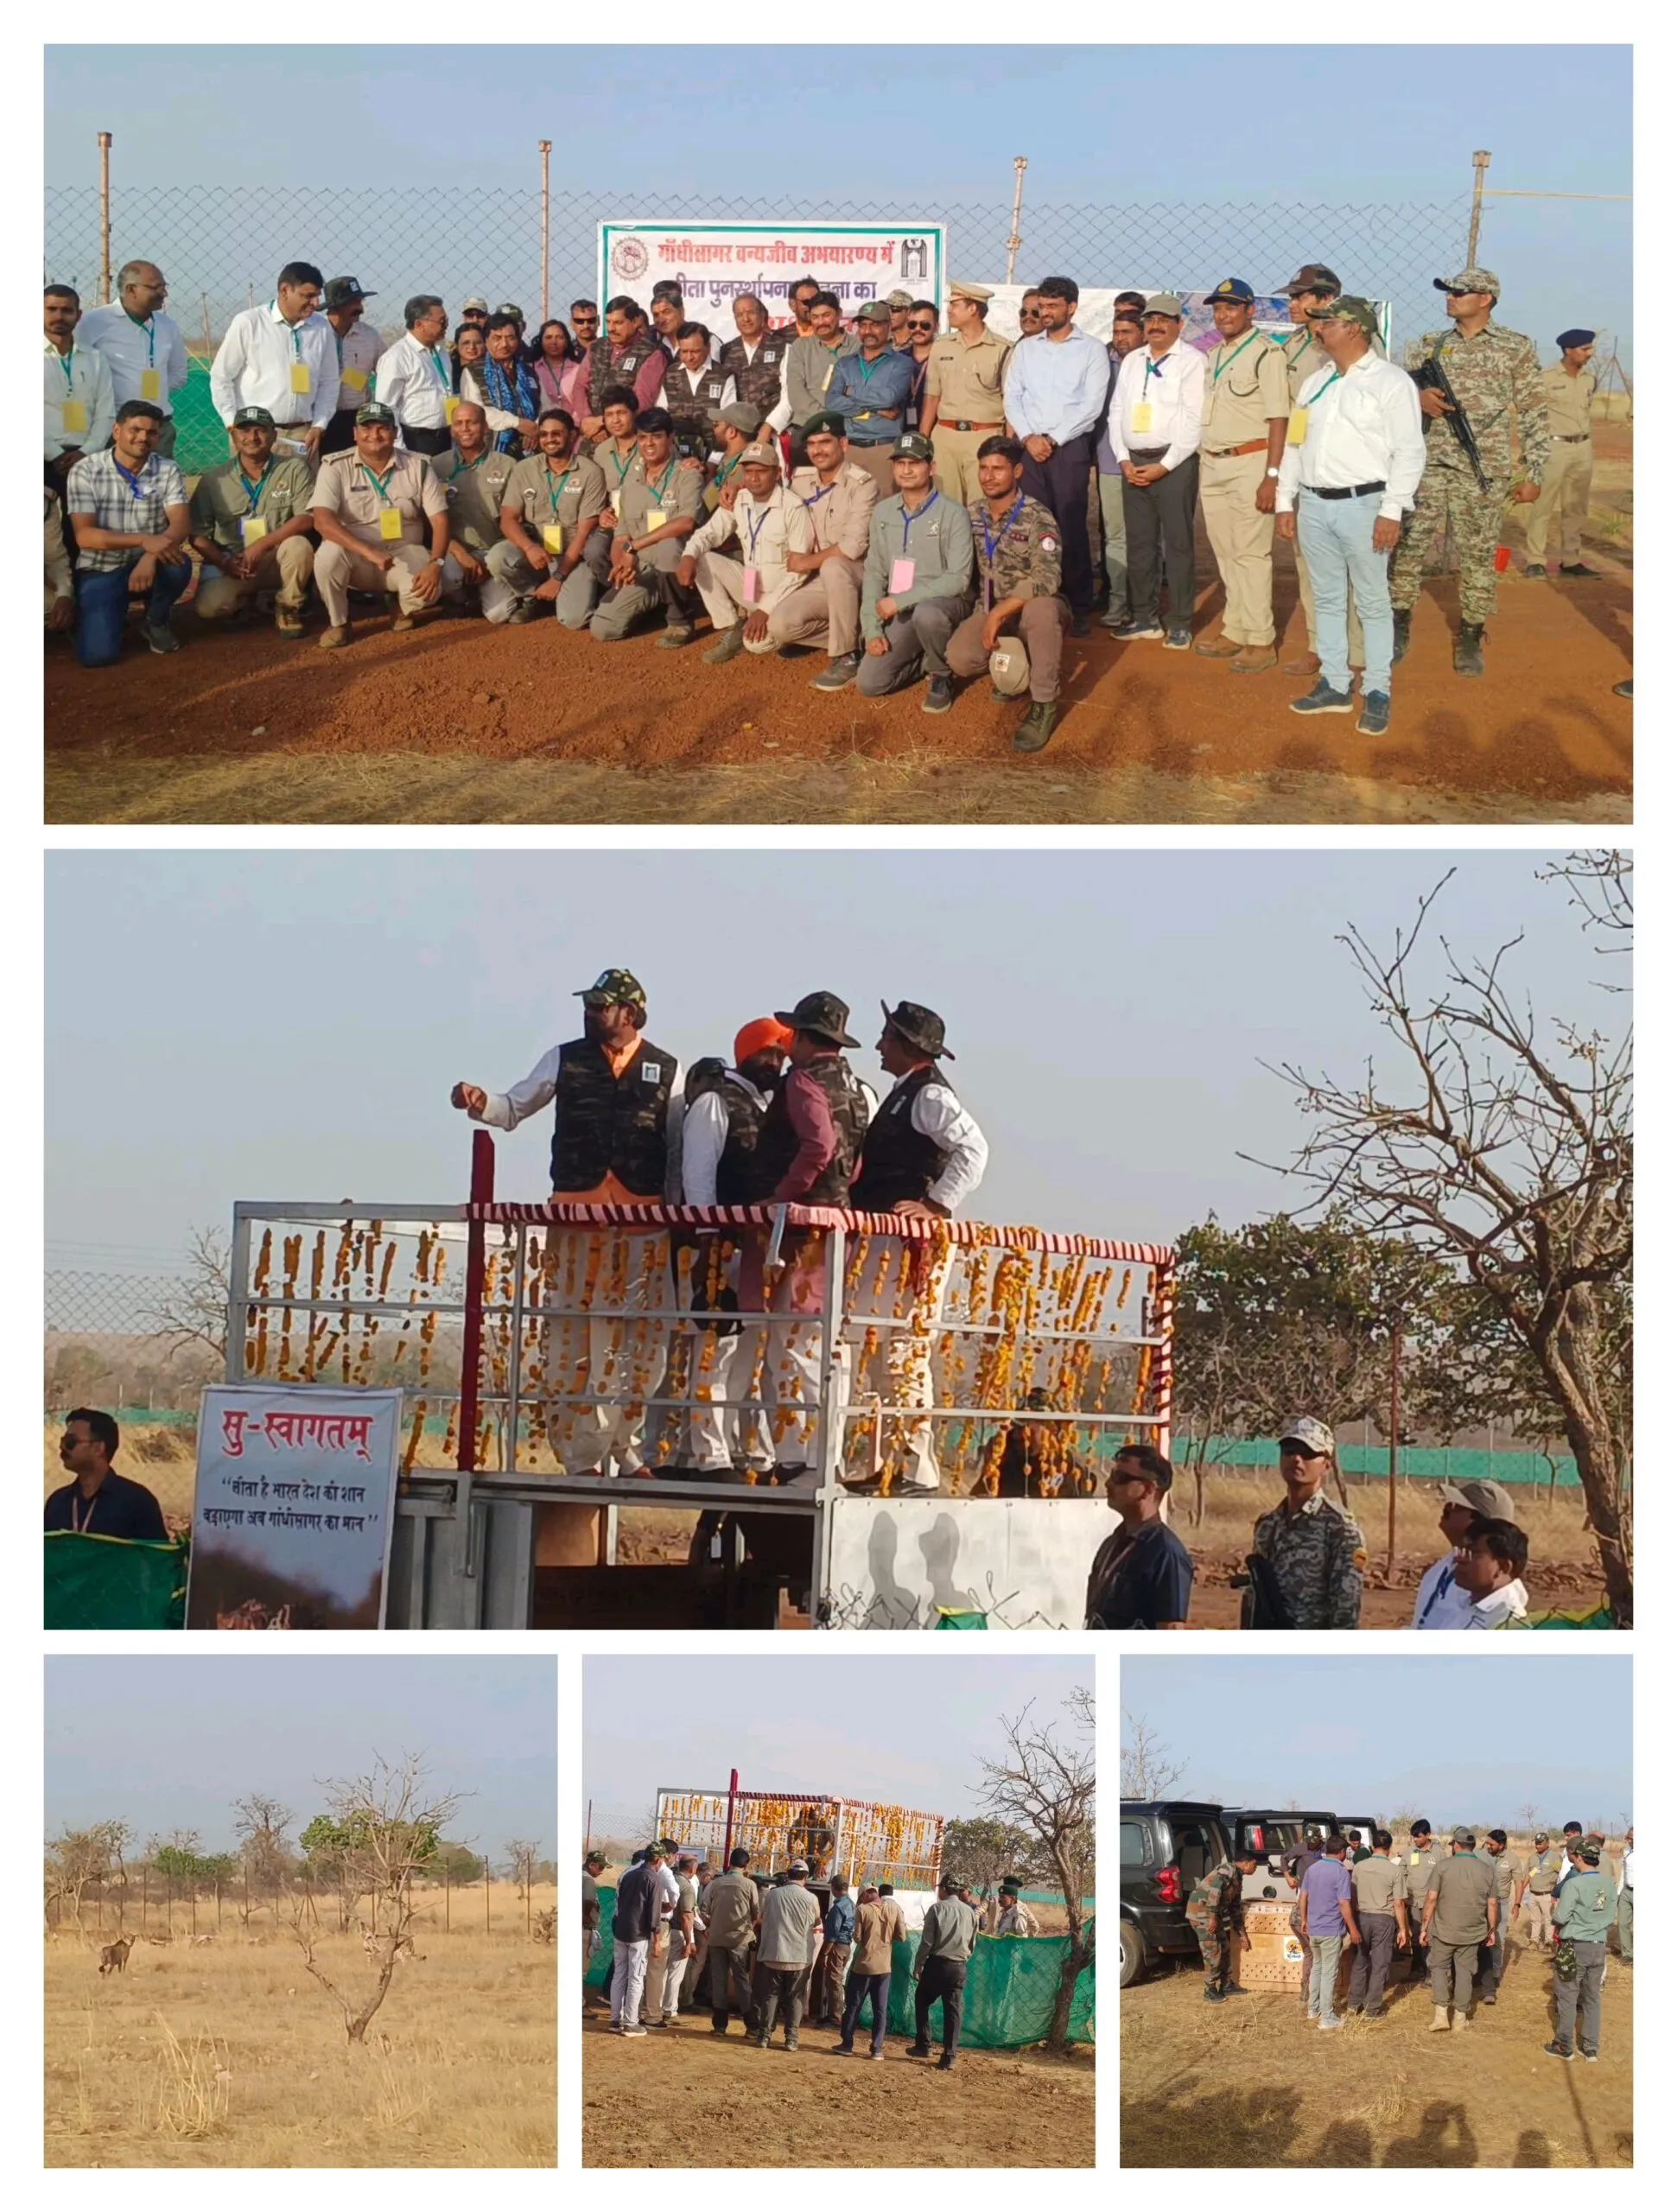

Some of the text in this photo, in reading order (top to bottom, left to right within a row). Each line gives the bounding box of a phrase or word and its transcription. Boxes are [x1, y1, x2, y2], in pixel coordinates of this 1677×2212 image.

[735, 240, 797, 264] वन्यजीव
[800, 245, 878, 264] अभयारण्य
[880, 239, 895, 264] में
[853, 281, 877, 299] का
[221, 1410, 374, 1464] सु-स्वागतम्
[260, 1474, 270, 1501] है
[272, 1482, 301, 1502] भारत
[302, 1478, 320, 1501] देश
[323, 1479, 340, 1502] की
[340, 1485, 366, 1503] शान
[246, 1510, 266, 1528] अब
[324, 1514, 340, 1531] का
